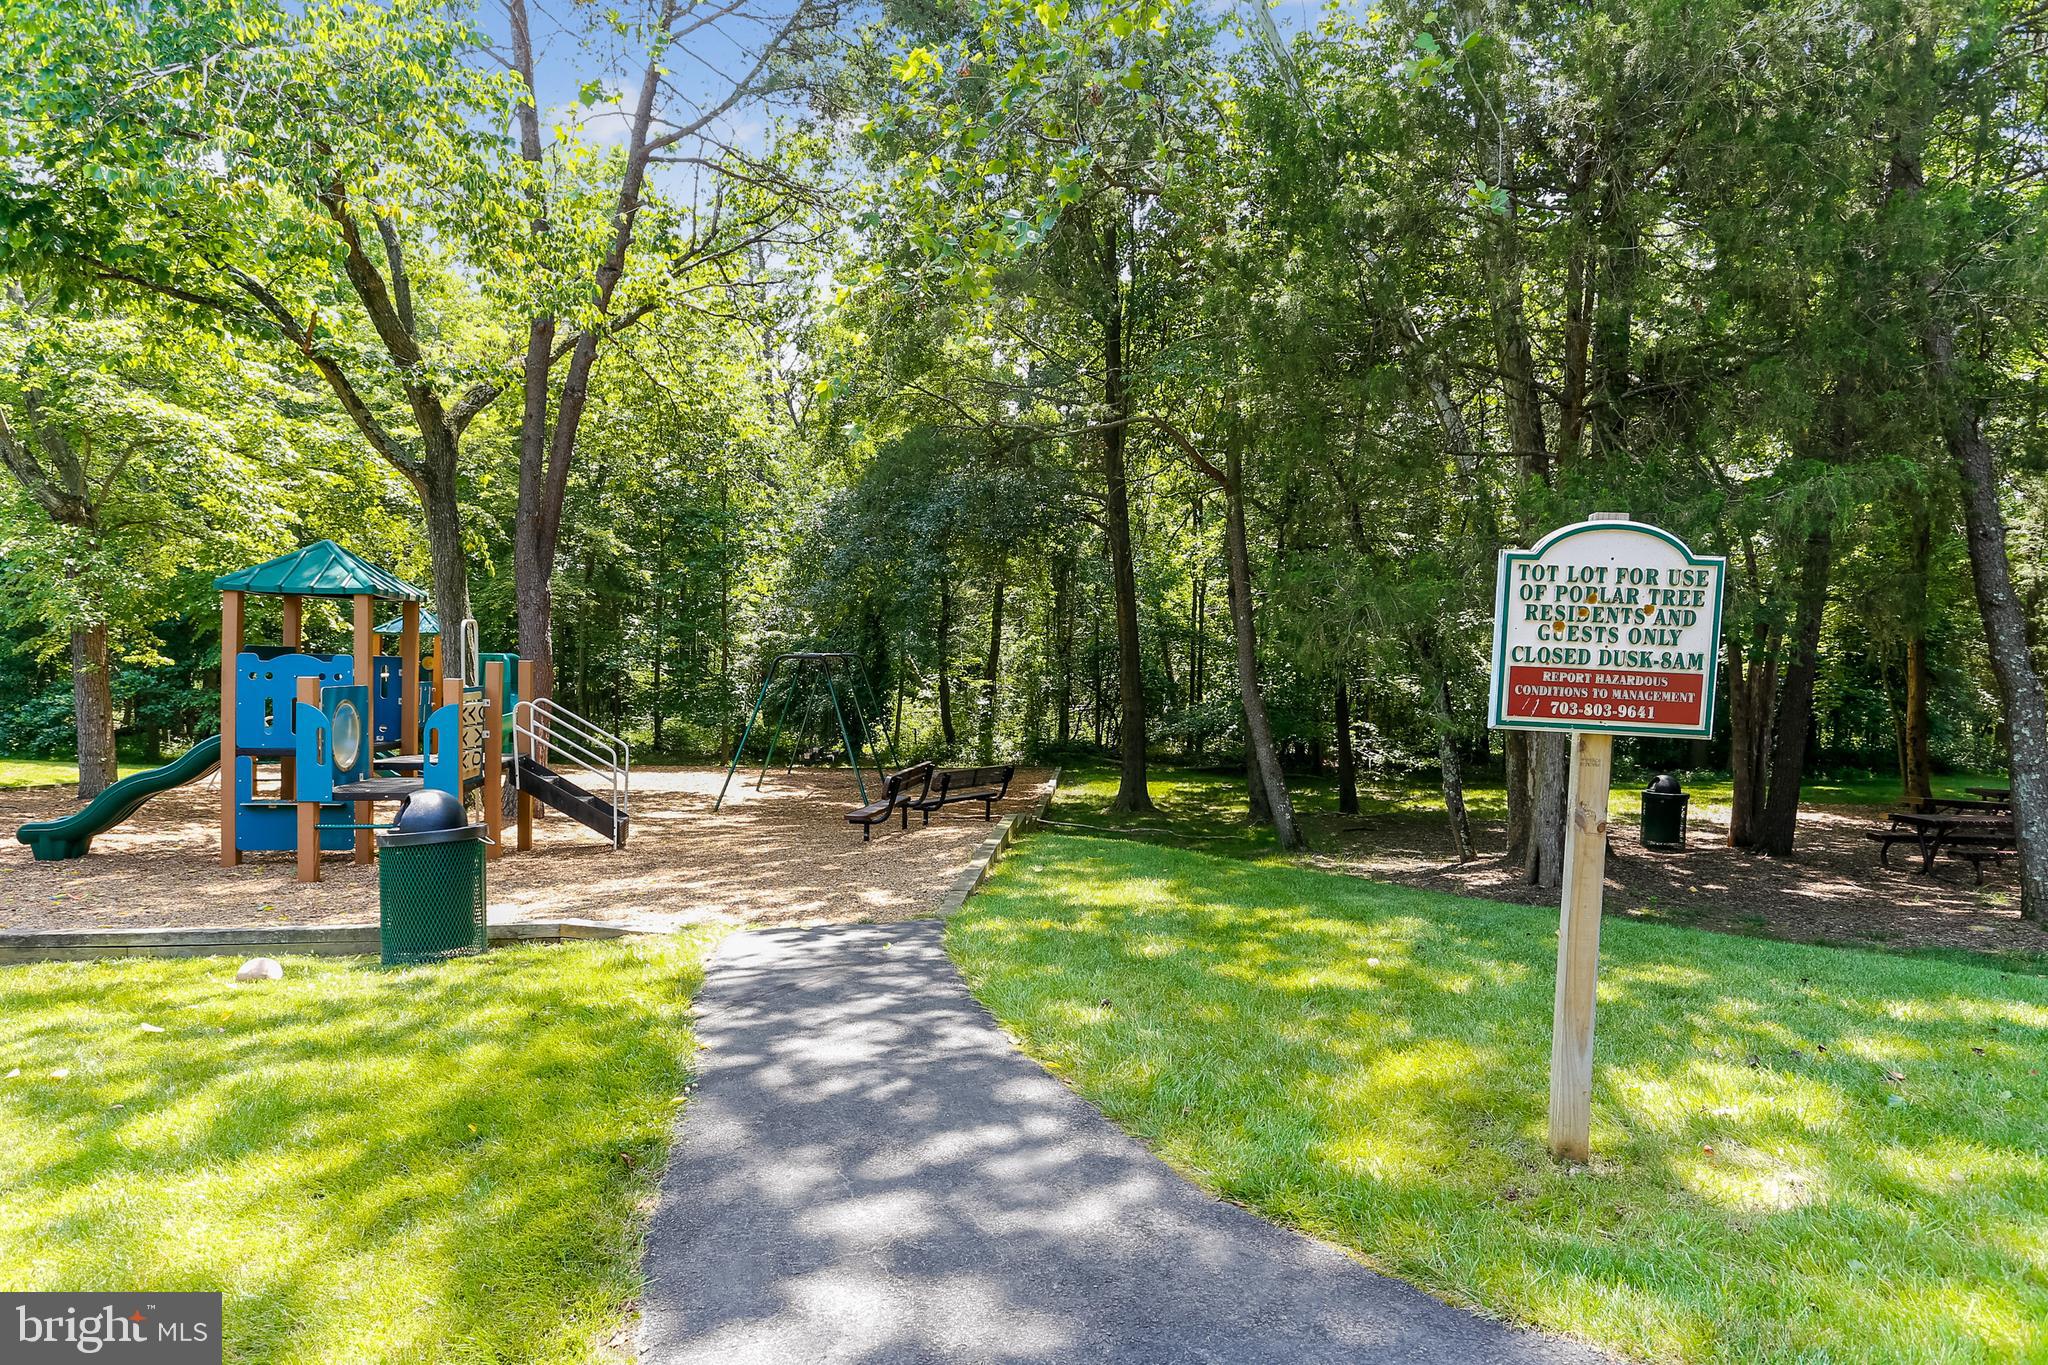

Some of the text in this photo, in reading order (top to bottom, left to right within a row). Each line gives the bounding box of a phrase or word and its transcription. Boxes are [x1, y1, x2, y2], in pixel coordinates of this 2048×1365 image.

[1519, 564, 1709, 587] TOT LOT FOR USE
[1519, 584, 1547, 601] OF
[1649, 589, 1705, 607] TREE
[1525, 604, 1696, 627] RESIDENTS AND
[1628, 627, 1682, 646] ONLY
[1512, 646, 1704, 670] CLOSED DUSK-8AM
[1543, 671, 1668, 687] REPORT HAZARDOUS
[1515, 685, 1695, 703] CONDITIONS TO MANAGEMENT
[1551, 702, 1655, 719] 703-803-9641
